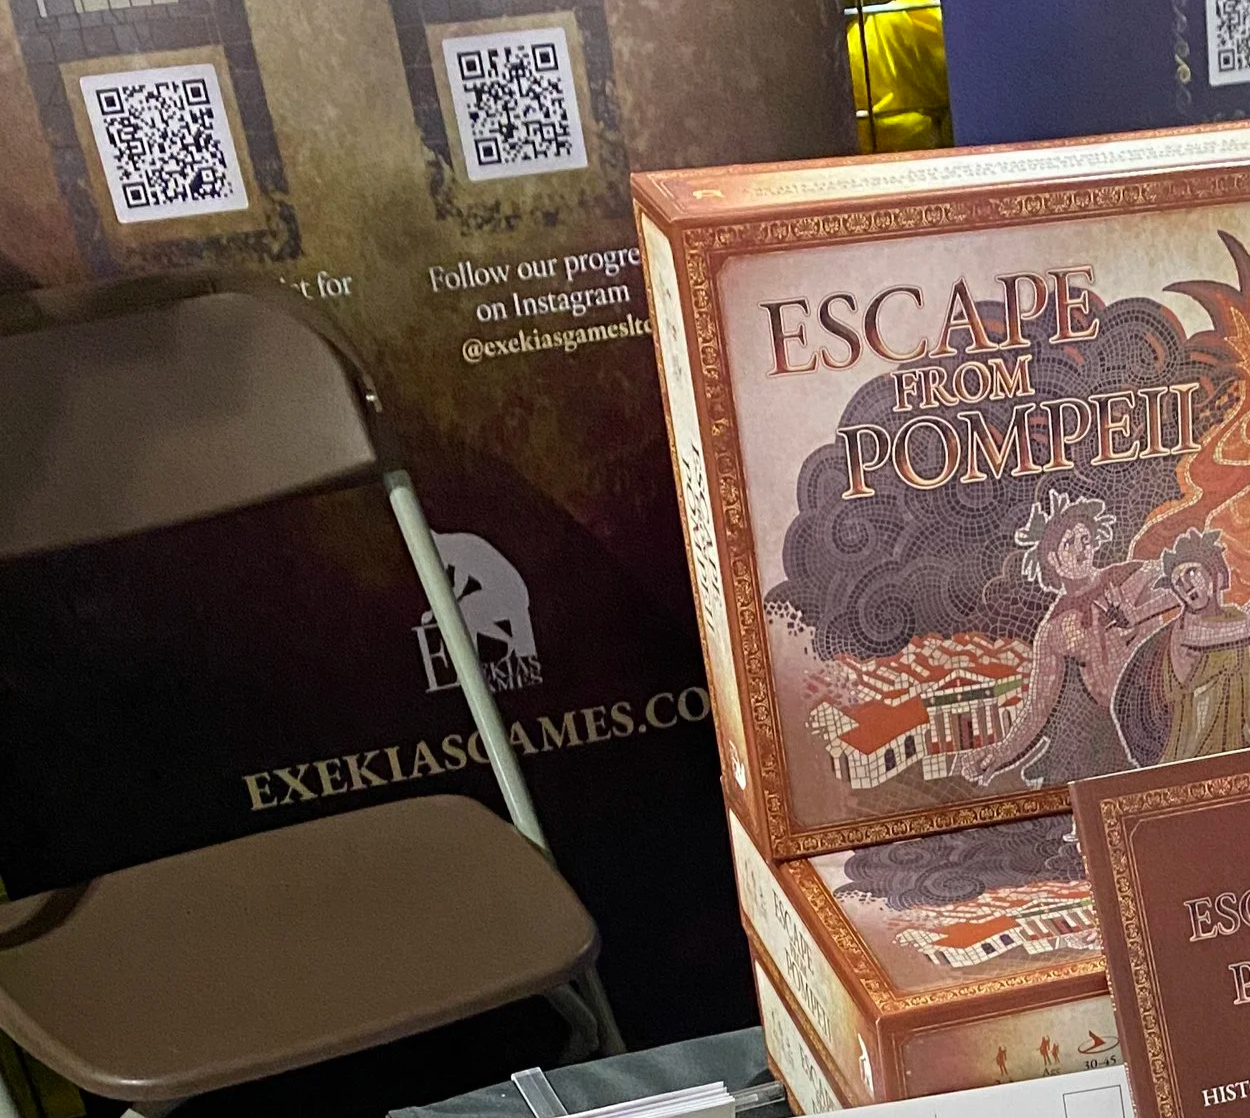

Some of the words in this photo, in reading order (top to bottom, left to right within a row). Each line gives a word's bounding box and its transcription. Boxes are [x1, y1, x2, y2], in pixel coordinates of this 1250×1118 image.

[317, 270, 353, 298] for
[429, 260, 510, 293] Follow
[517, 257, 557, 281] our
[563, 246, 641, 282] progre
[476, 301, 507, 322] on
[512, 284, 630, 318] Instagram
[757, 265, 1101, 379] ESCAPE
[890, 353, 1036, 415] FROM
[838, 381, 1203, 502] POMPEII
[242, 686, 711, 811] EXEKIASAMES.CO
